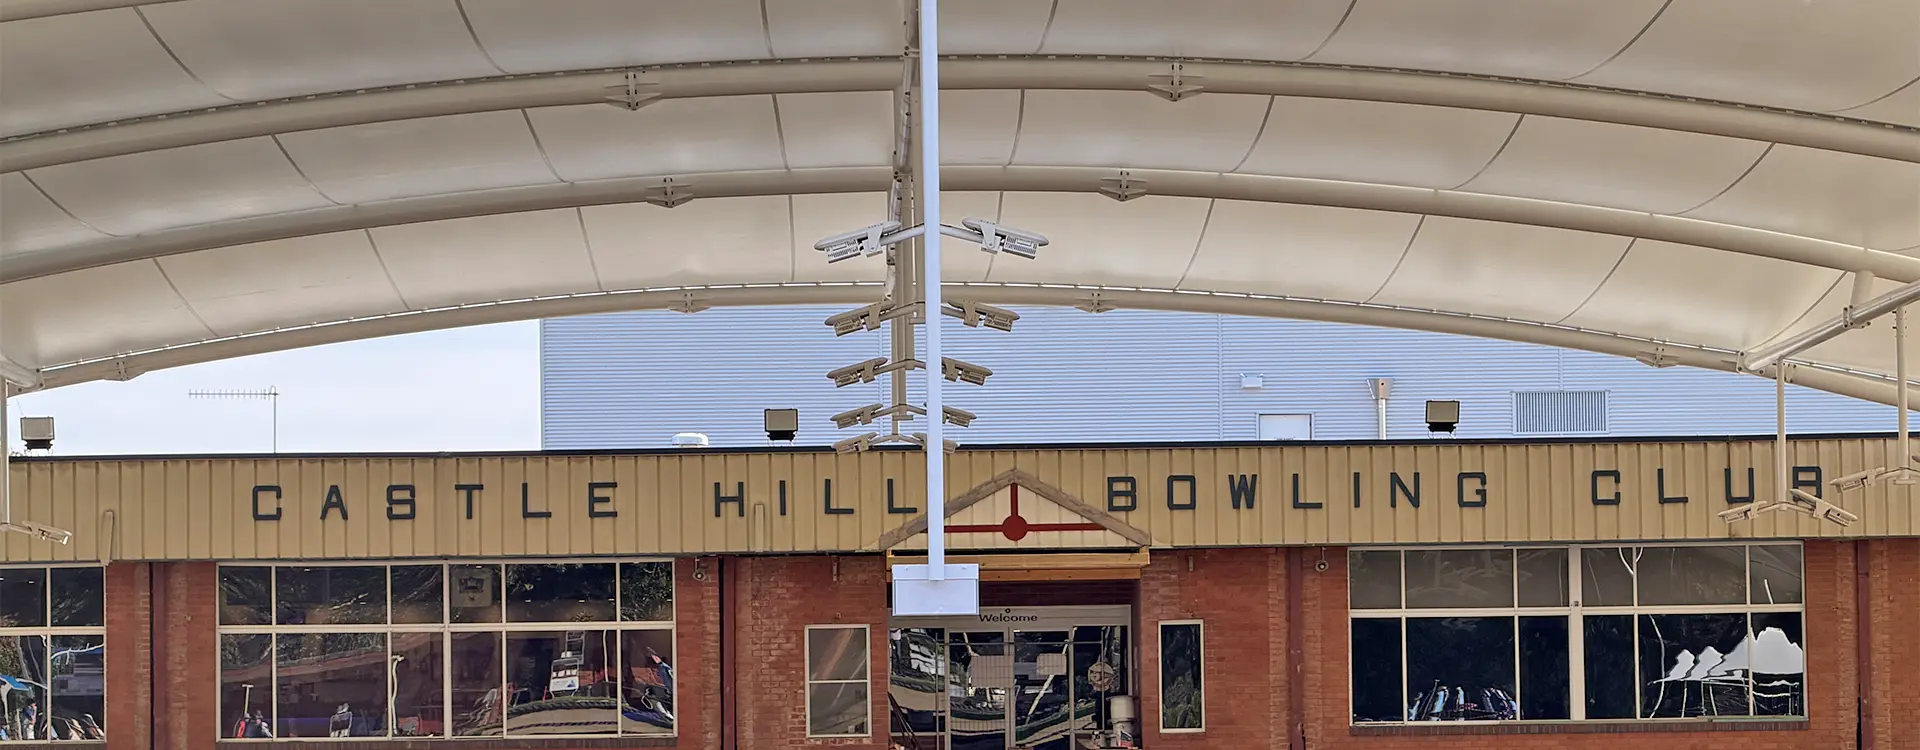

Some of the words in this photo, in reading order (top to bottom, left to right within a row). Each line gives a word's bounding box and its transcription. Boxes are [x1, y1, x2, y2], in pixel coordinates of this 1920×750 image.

[251, 480, 619, 524] CASTLE
[713, 477, 919, 518] HILL
[1106, 471, 1488, 513] BOWLING
[1590, 464, 1824, 510] CLUB
[979, 613, 1038, 622] Welcome
